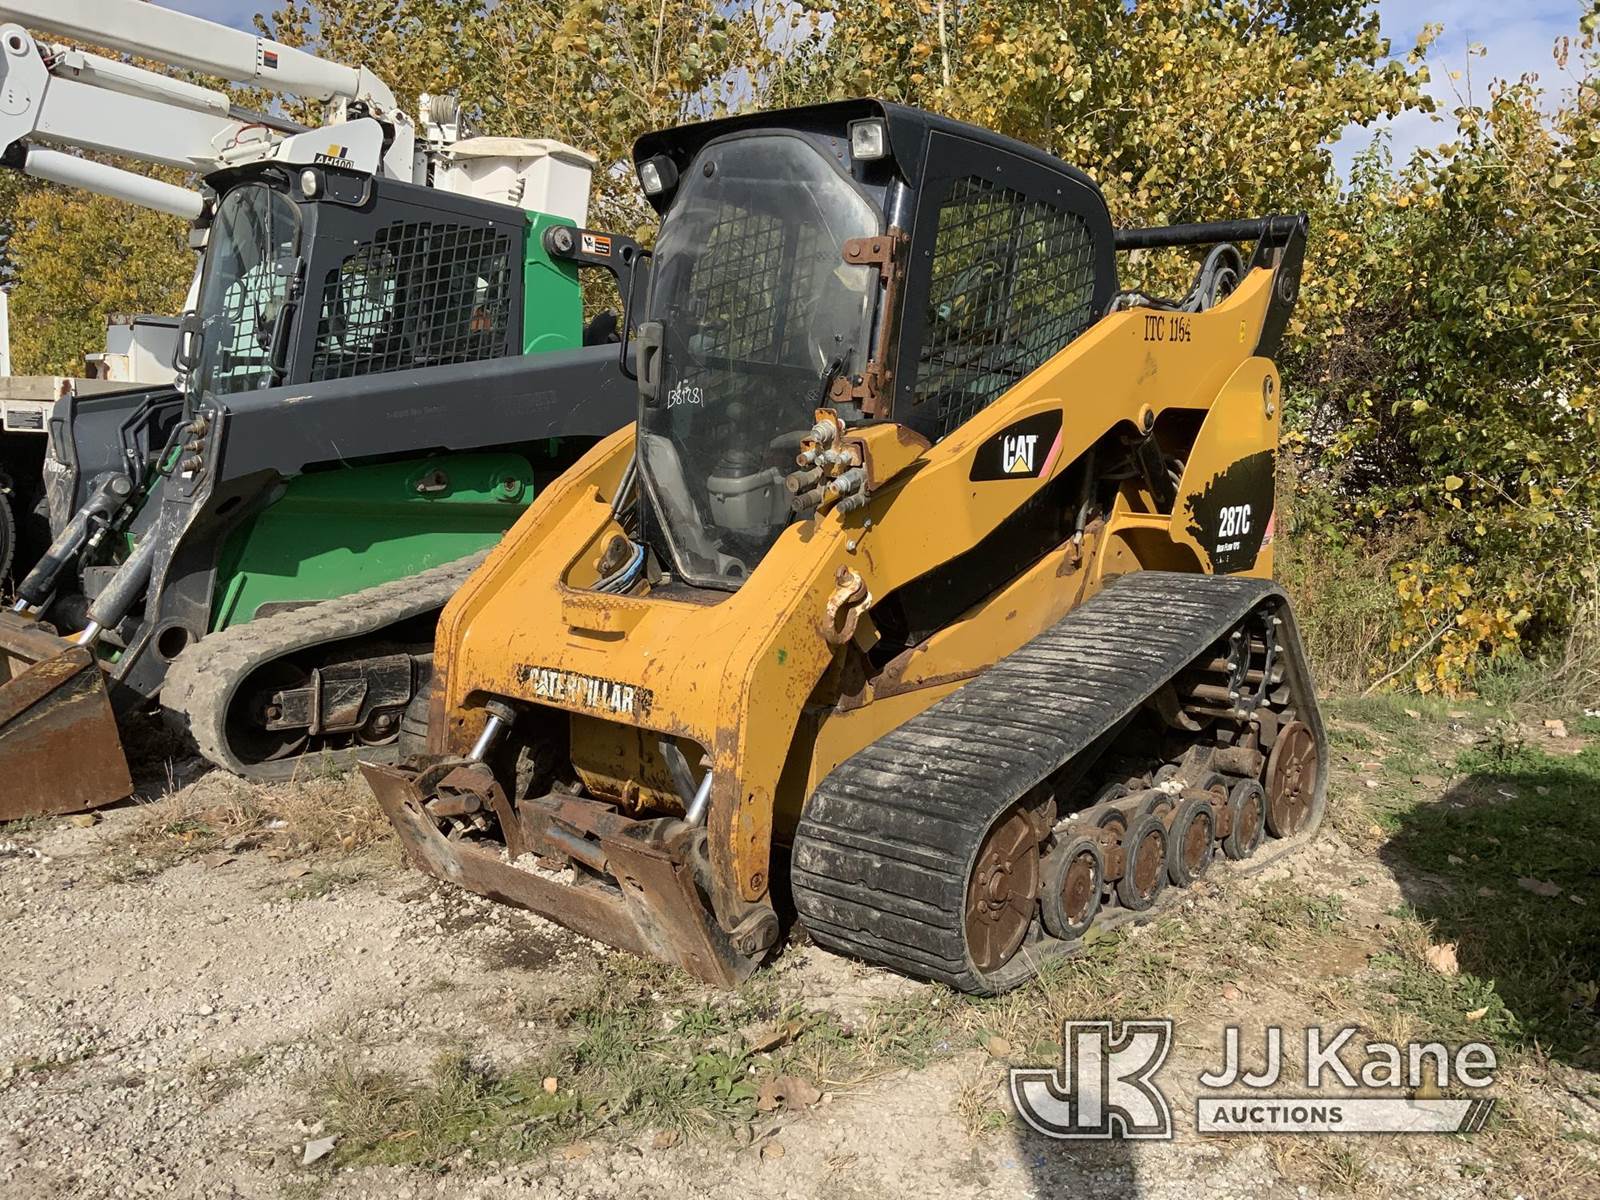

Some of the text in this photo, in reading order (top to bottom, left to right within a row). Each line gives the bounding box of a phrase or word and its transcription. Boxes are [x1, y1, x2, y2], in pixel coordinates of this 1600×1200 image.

[1144, 315, 1191, 342] ITC 1164
[1003, 434, 1037, 473] CAT
[1218, 504, 1250, 537] 287C
